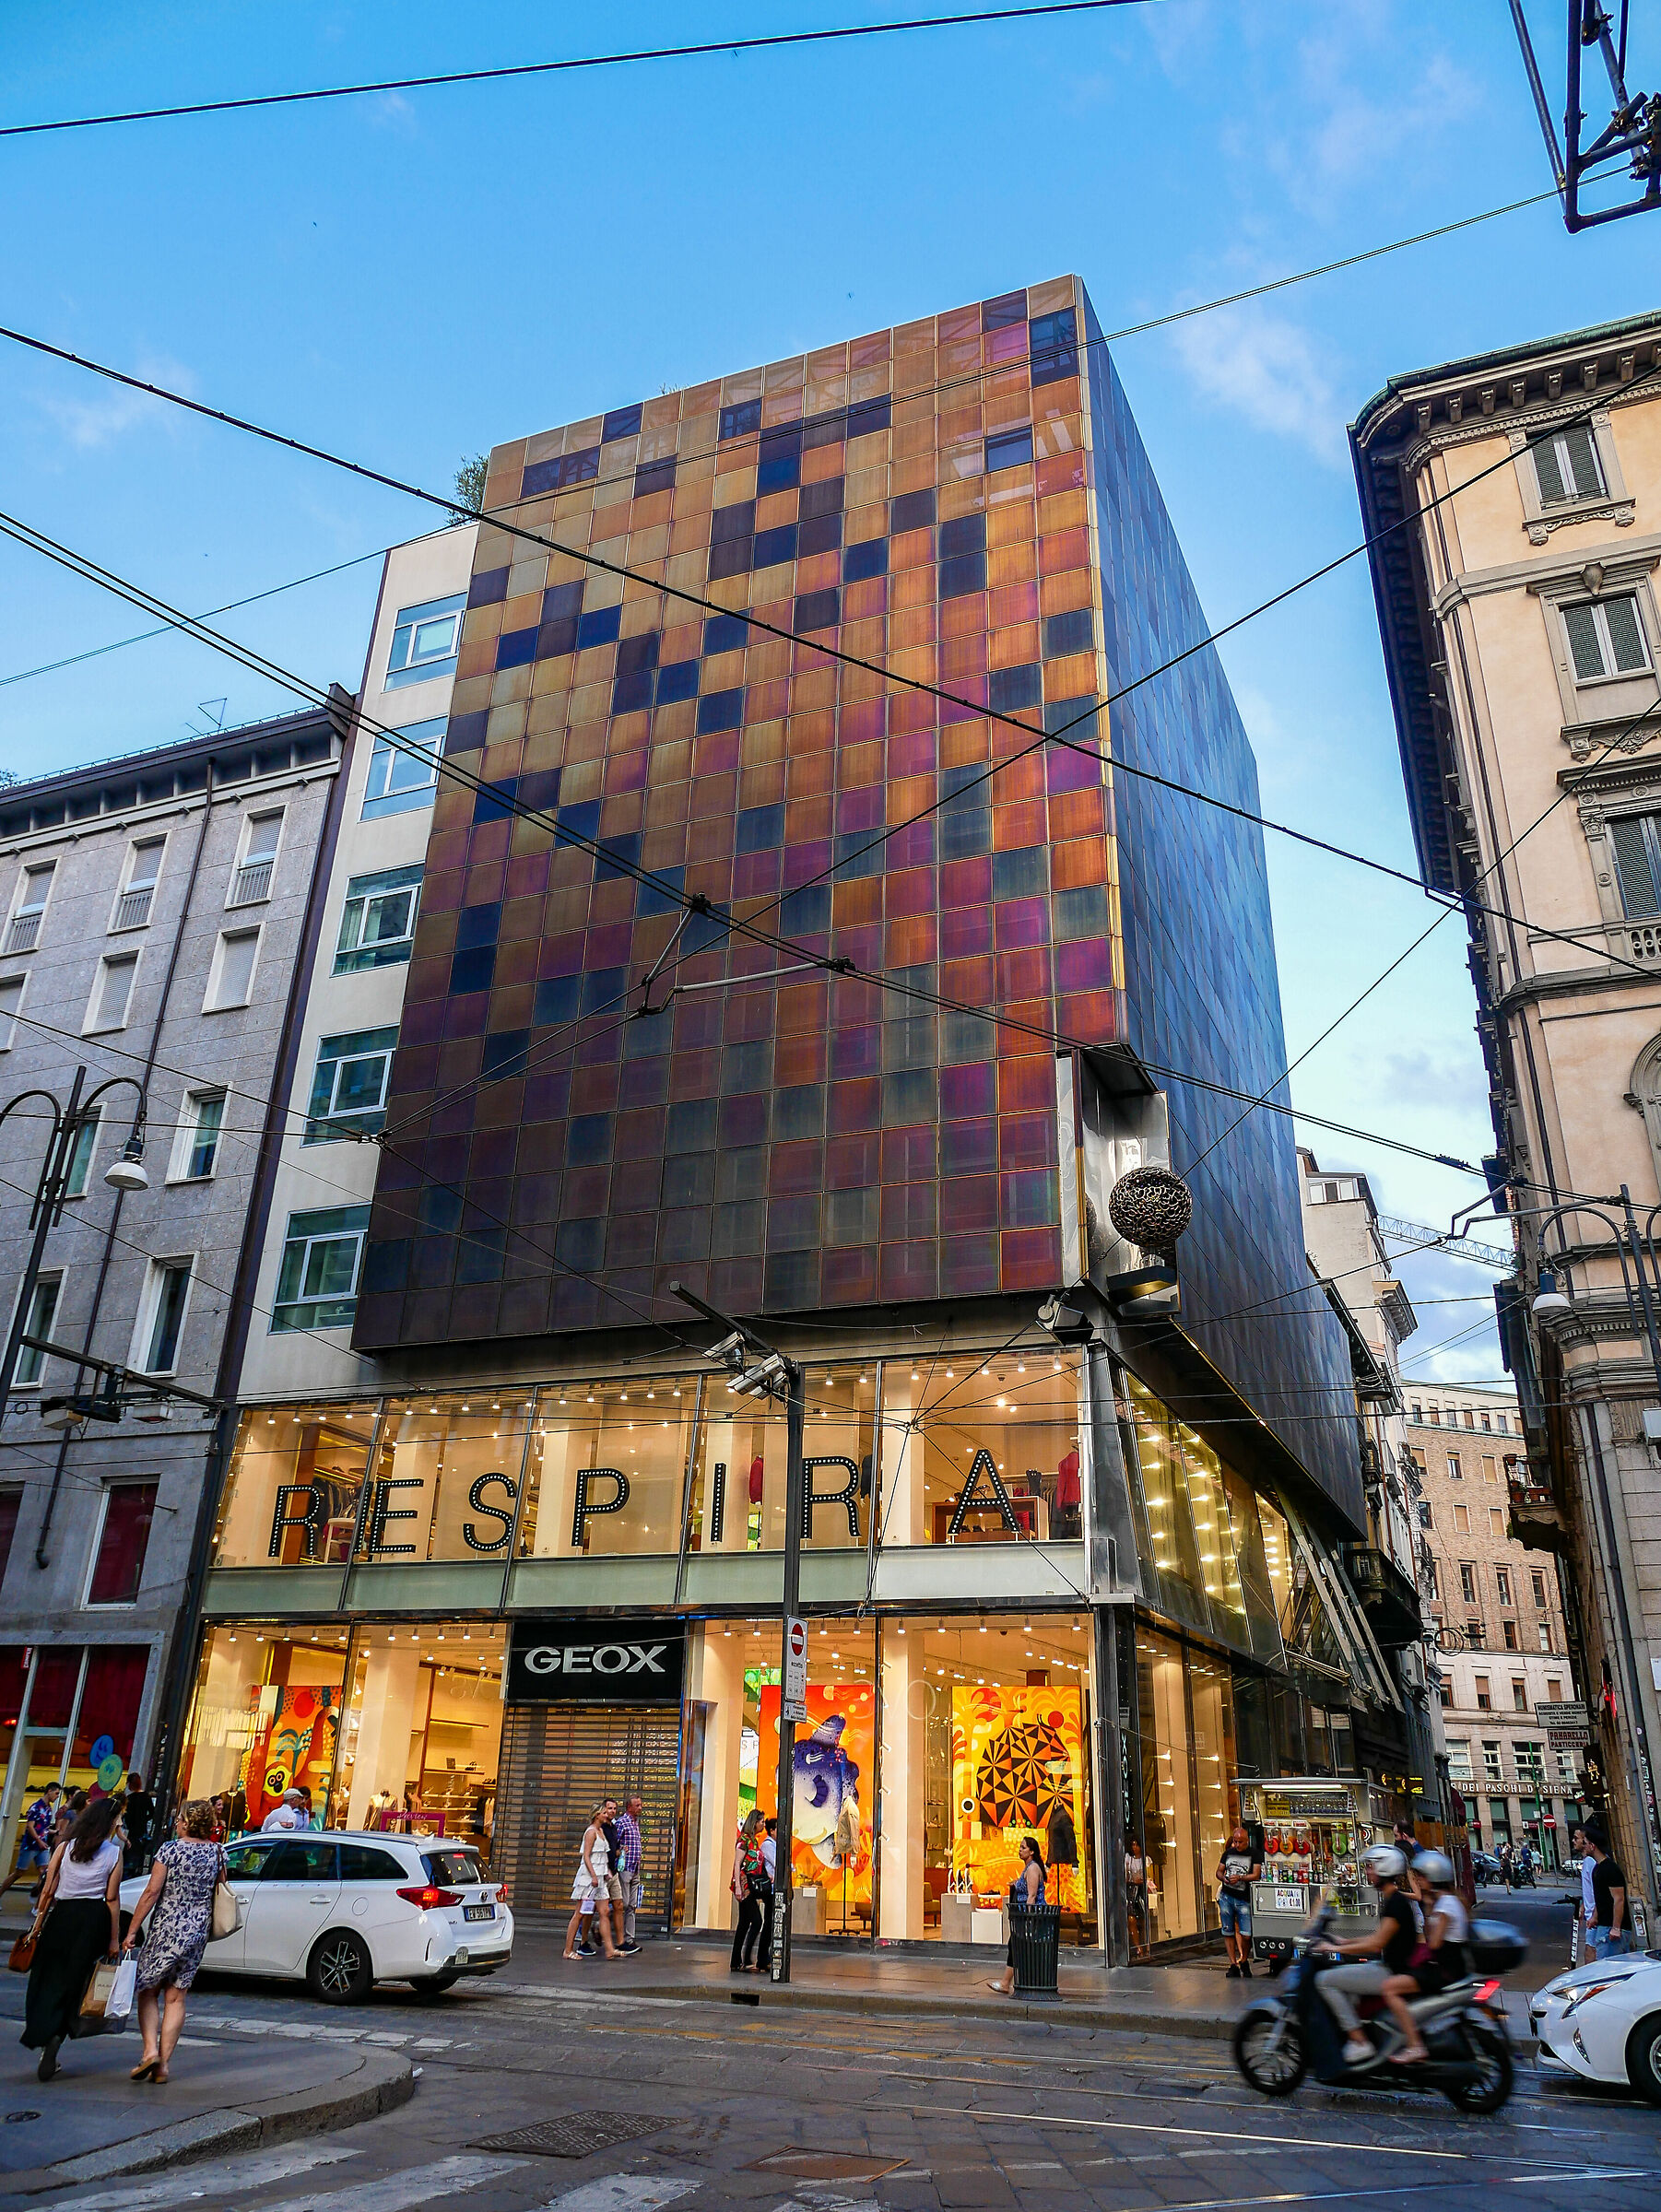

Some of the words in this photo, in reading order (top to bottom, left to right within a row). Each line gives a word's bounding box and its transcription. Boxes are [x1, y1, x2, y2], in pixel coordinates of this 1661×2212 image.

[267, 1449, 1020, 1559] RESPIRA
[524, 1645, 667, 1674] GEOX
[1549, 1731, 1588, 1740] PANARELLO
[1462, 1783, 1479, 1792] DEI
[1486, 1783, 1521, 1793] PASCHI
[1543, 1785, 1573, 1794] SIENA
